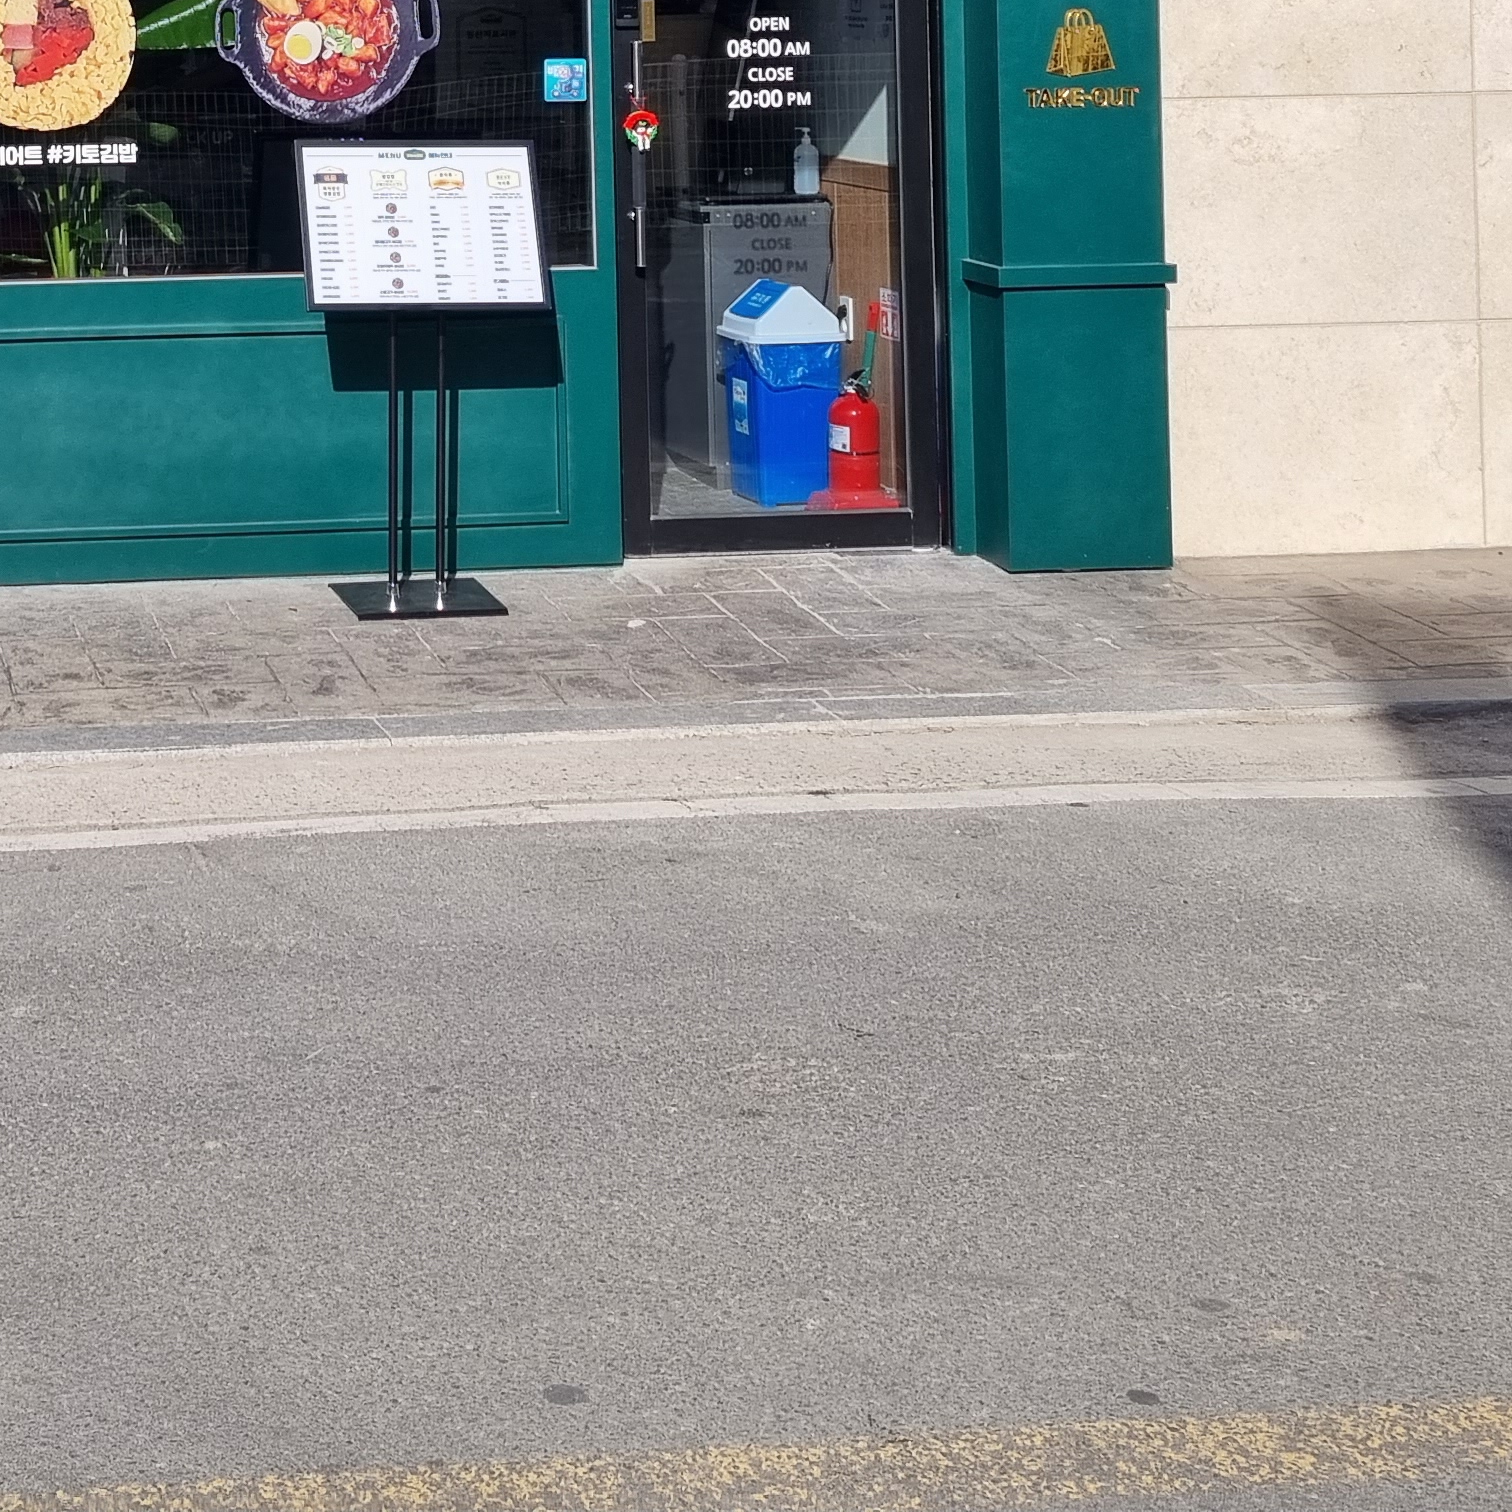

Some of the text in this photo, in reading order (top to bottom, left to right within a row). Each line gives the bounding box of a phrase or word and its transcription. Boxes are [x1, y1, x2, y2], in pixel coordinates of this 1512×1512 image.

[749, 16, 790, 32] OPEN
[726, 38, 811, 58] 08:00 AM
[747, 66, 794, 82] CLOSE
[727, 88, 812, 109] 20:00 PM
[1023, 86, 1140, 108] TAKE-OUT
[47, 142, 139, 165] #키토김밥
